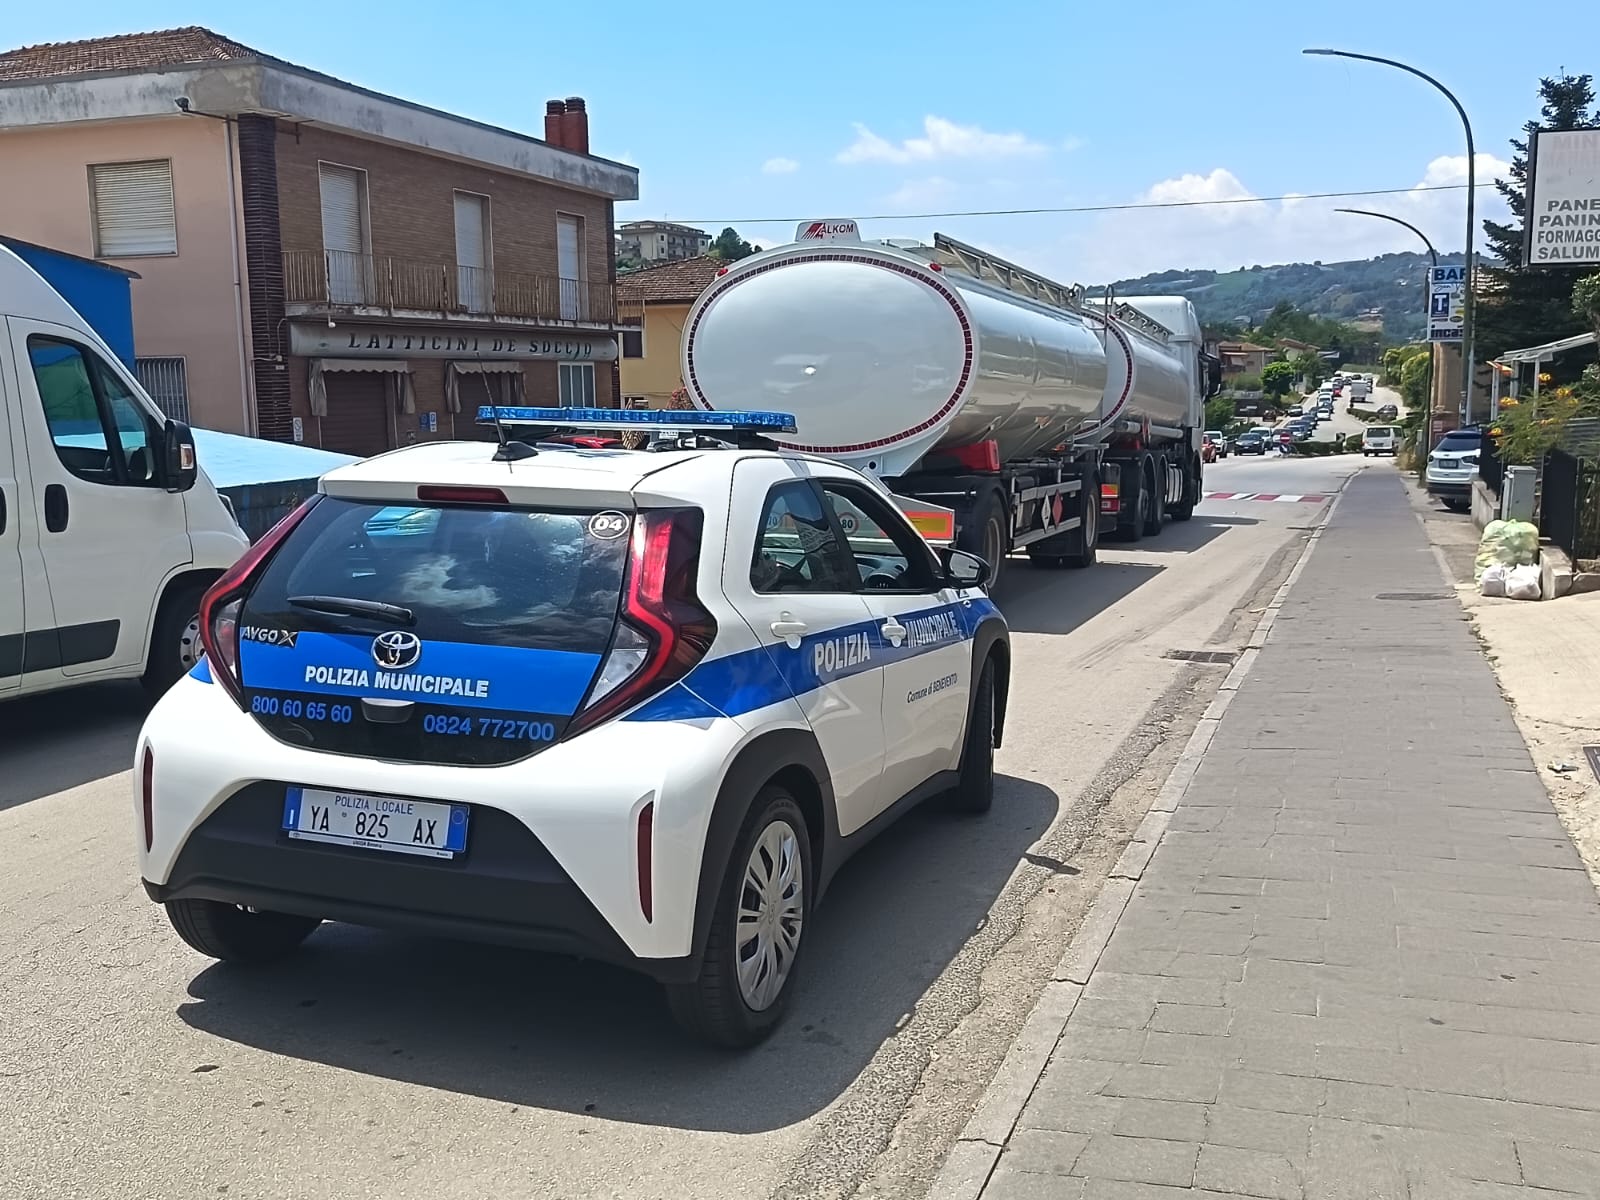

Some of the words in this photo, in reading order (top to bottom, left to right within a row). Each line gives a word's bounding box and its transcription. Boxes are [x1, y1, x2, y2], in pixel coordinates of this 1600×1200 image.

[1547, 199, 1600, 212] PANE
[348, 333, 479, 351] LATTICINI
[492, 339, 517, 352] DE
[593, 518, 622, 531] 04
[841, 519, 853, 529] 80
[814, 631, 871, 676] POLIZIA
[905, 611, 959, 649] MUNICIPALE
[304, 665, 369, 687] POLIZIA
[374, 672, 489, 698] MUNICIPALE
[907, 687, 928, 703] Comune
[928, 681, 933, 695] di
[252, 696, 279, 714] 800
[283, 699, 301, 718] 60
[306, 702, 326, 721] 65
[331, 705, 352, 723] 60
[424, 714, 472, 735] 0824
[479, 718, 555, 741] 772700
[335, 795, 370, 810] POLIZIA
[375, 801, 414, 815] LOCALE
[311, 805, 329, 832] YA
[355, 811, 390, 839] 825
[412, 818, 437, 845] AX
